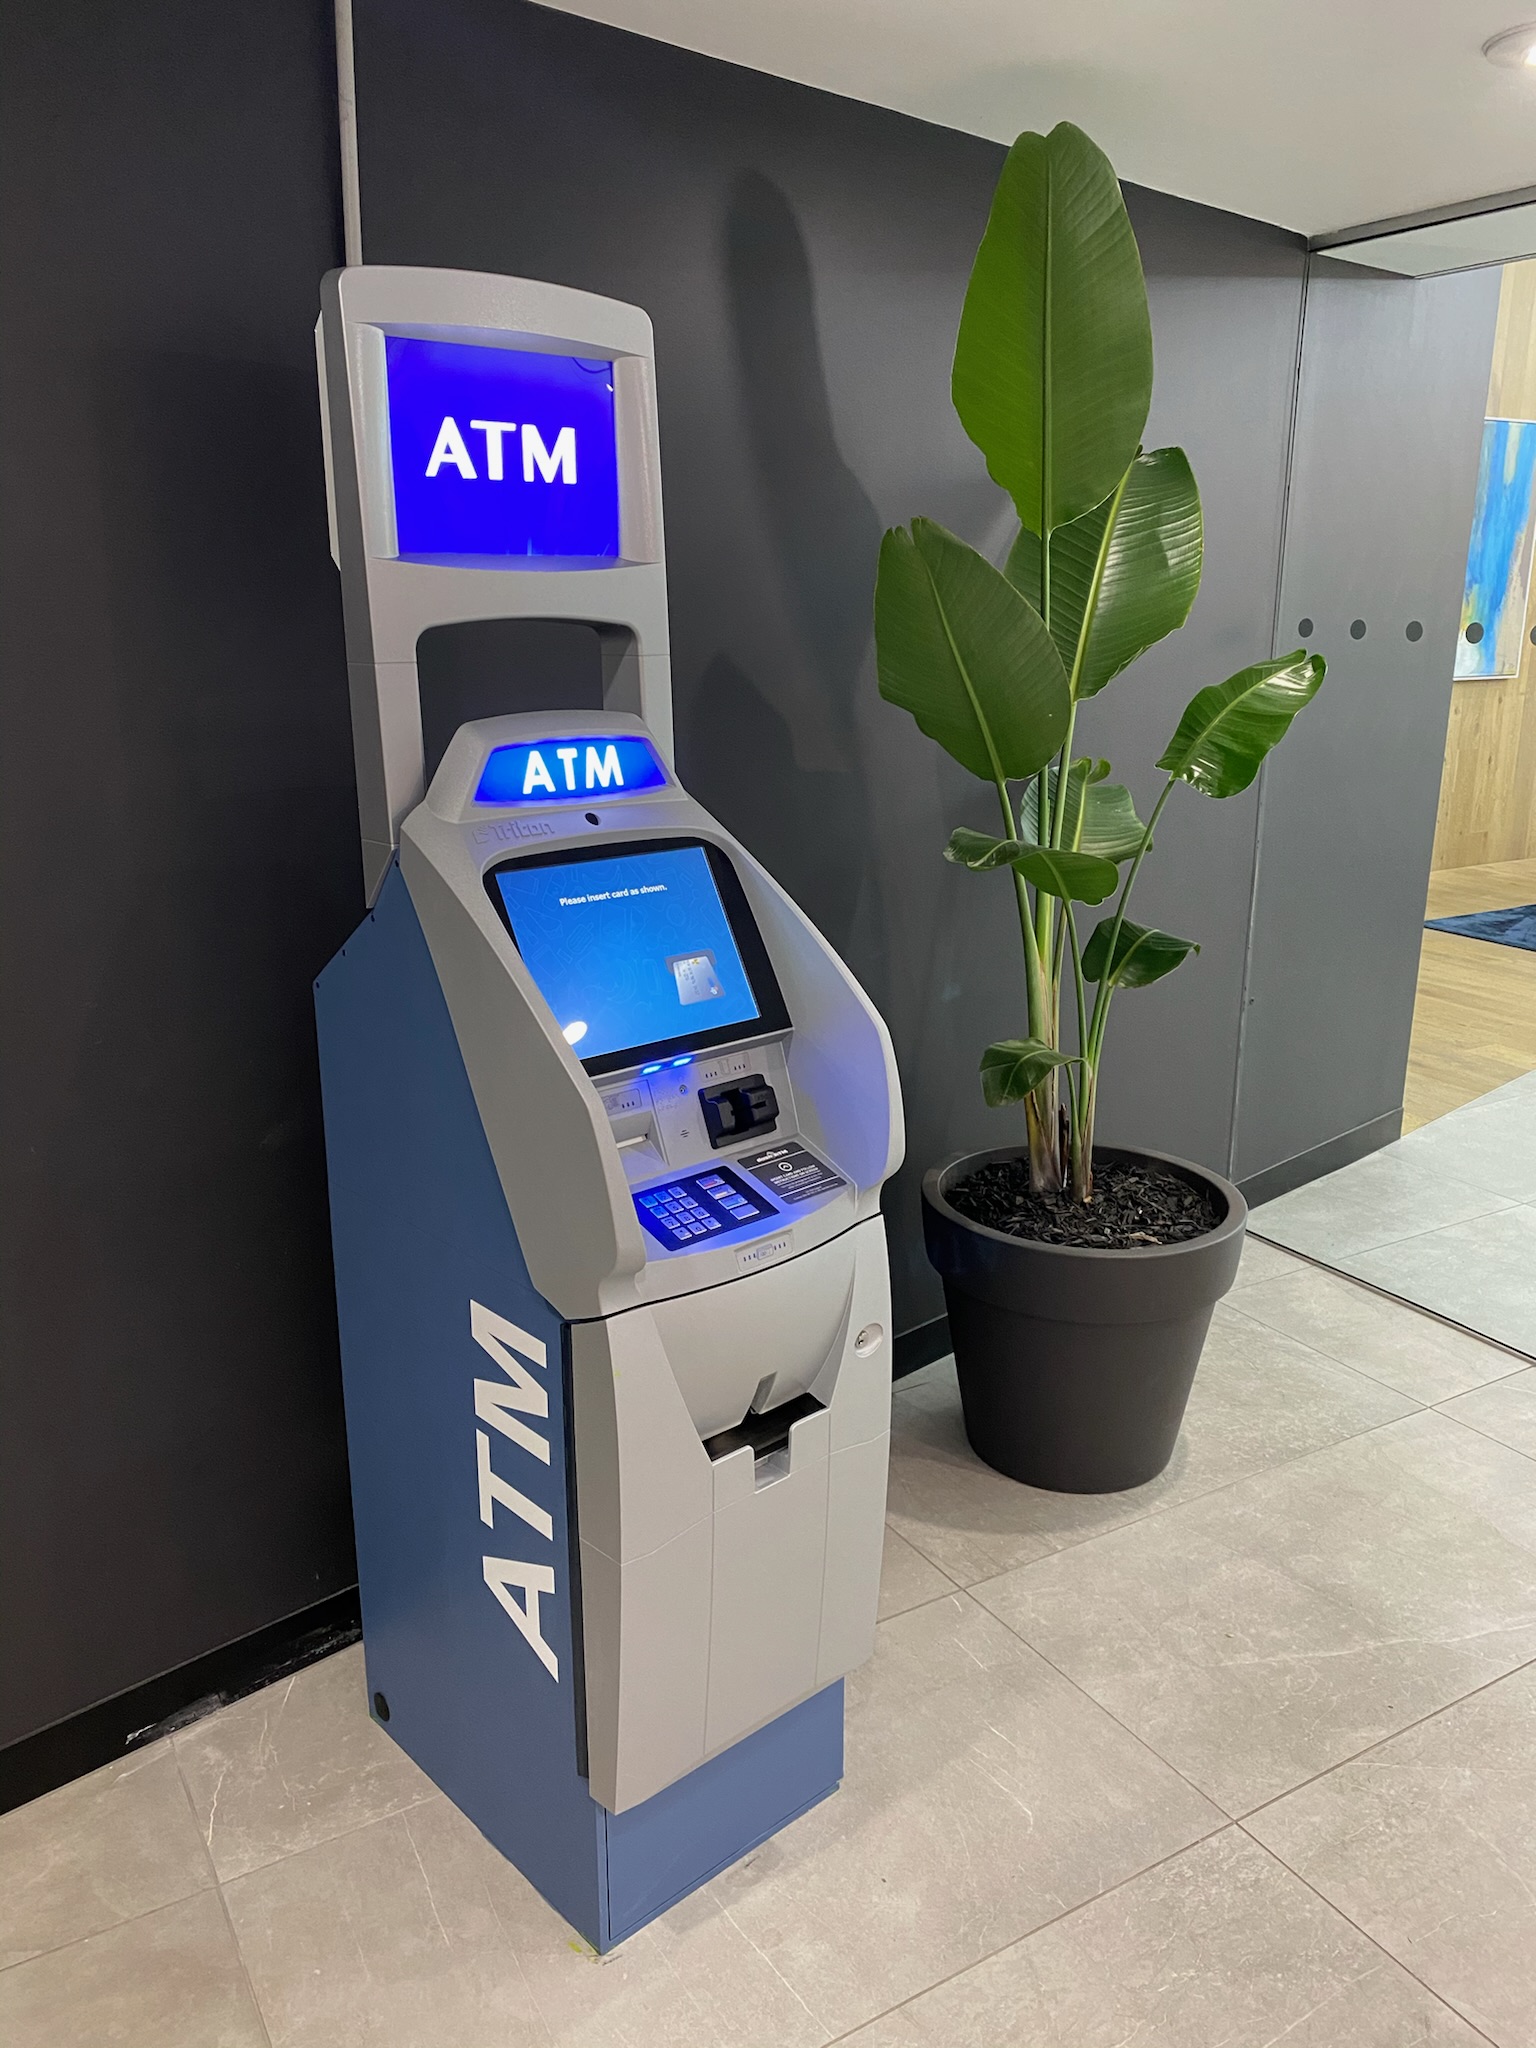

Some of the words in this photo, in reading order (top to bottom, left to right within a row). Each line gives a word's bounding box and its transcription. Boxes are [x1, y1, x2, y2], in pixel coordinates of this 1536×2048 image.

[425, 416, 578, 485] ATM
[522, 744, 625, 795] ATM
[559, 896, 587, 907] Please
[587, 892, 611, 902] insert
[611, 888, 630, 899] card
[630, 888, 640, 896] as
[640, 884, 668, 894] shown.
[469, 1299, 560, 1684] ATM
